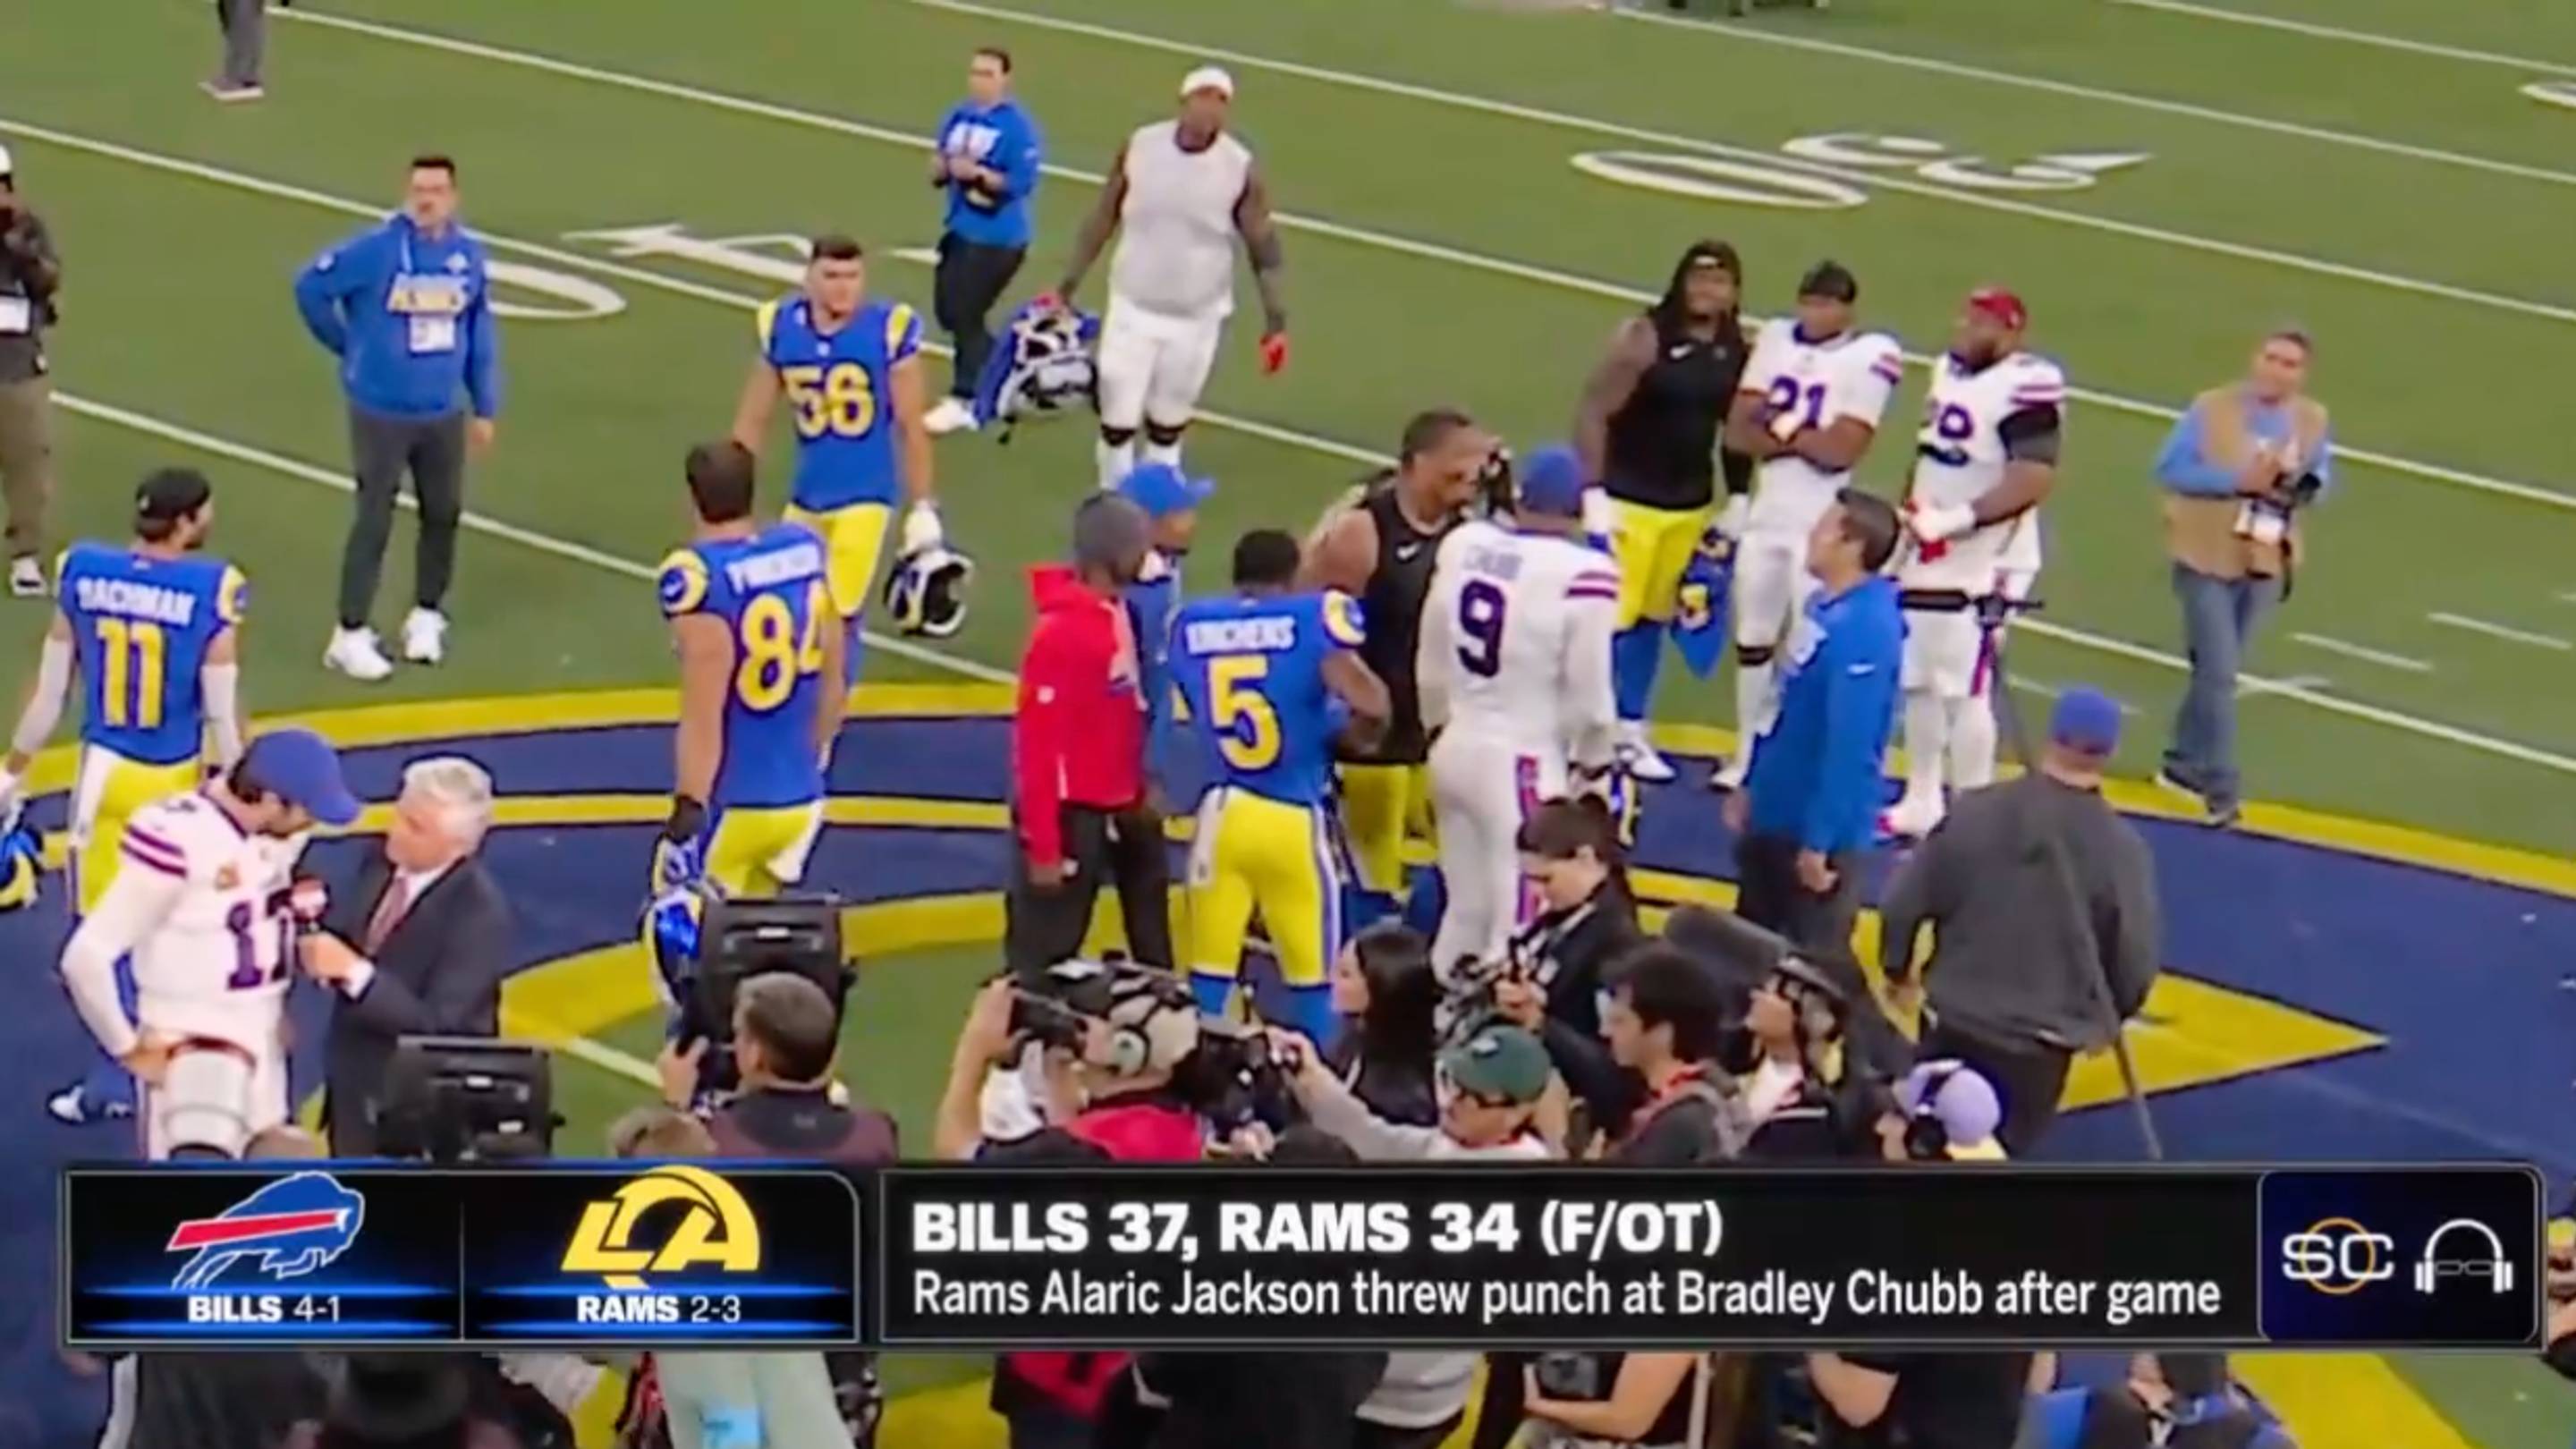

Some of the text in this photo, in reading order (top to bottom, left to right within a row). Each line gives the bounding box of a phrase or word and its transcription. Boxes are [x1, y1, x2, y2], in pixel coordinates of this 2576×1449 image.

[784, 361, 876, 438] 56
[96, 615, 165, 729] 11
[1456, 578, 1506, 679] 9
[1208, 654, 1283, 771] 5
